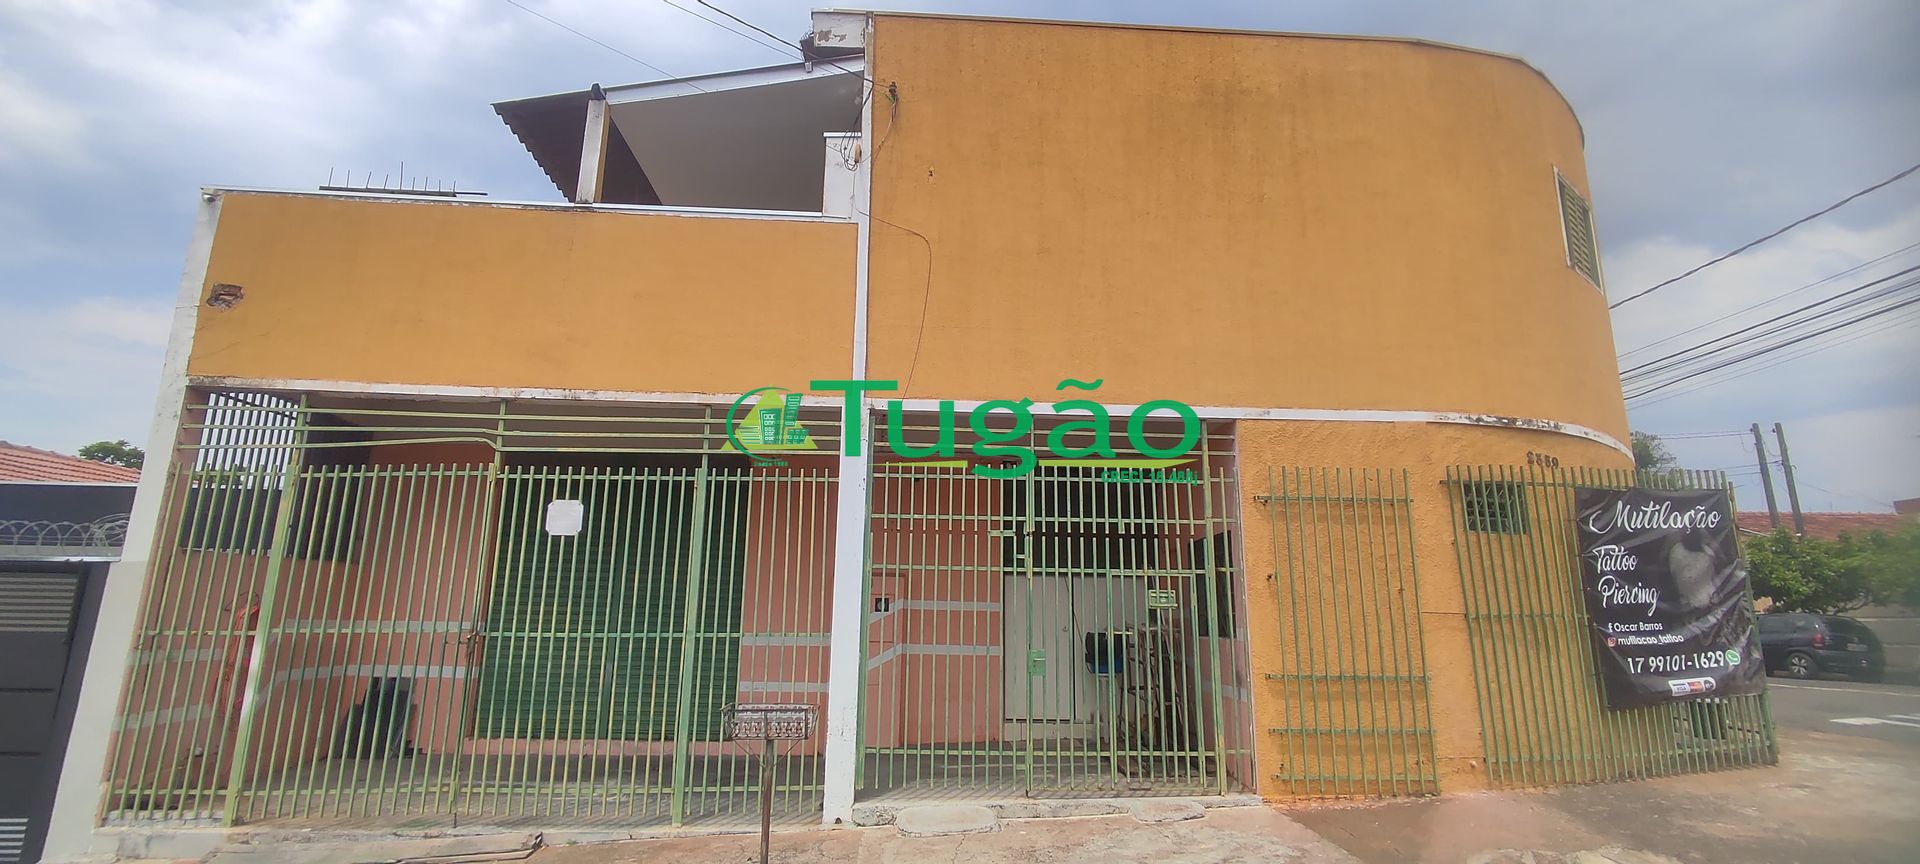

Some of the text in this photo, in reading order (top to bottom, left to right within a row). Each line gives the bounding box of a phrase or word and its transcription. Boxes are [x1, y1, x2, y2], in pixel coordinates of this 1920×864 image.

[1589, 500, 1721, 534] Mutilação
[1592, 544, 1638, 574] Tattoo
[1598, 575, 1660, 617] Piercing
[1614, 622, 1638, 632] Oscar
[1639, 621, 1663, 631] Barros
[1627, 650, 1724, 674] 17 99101-1629
